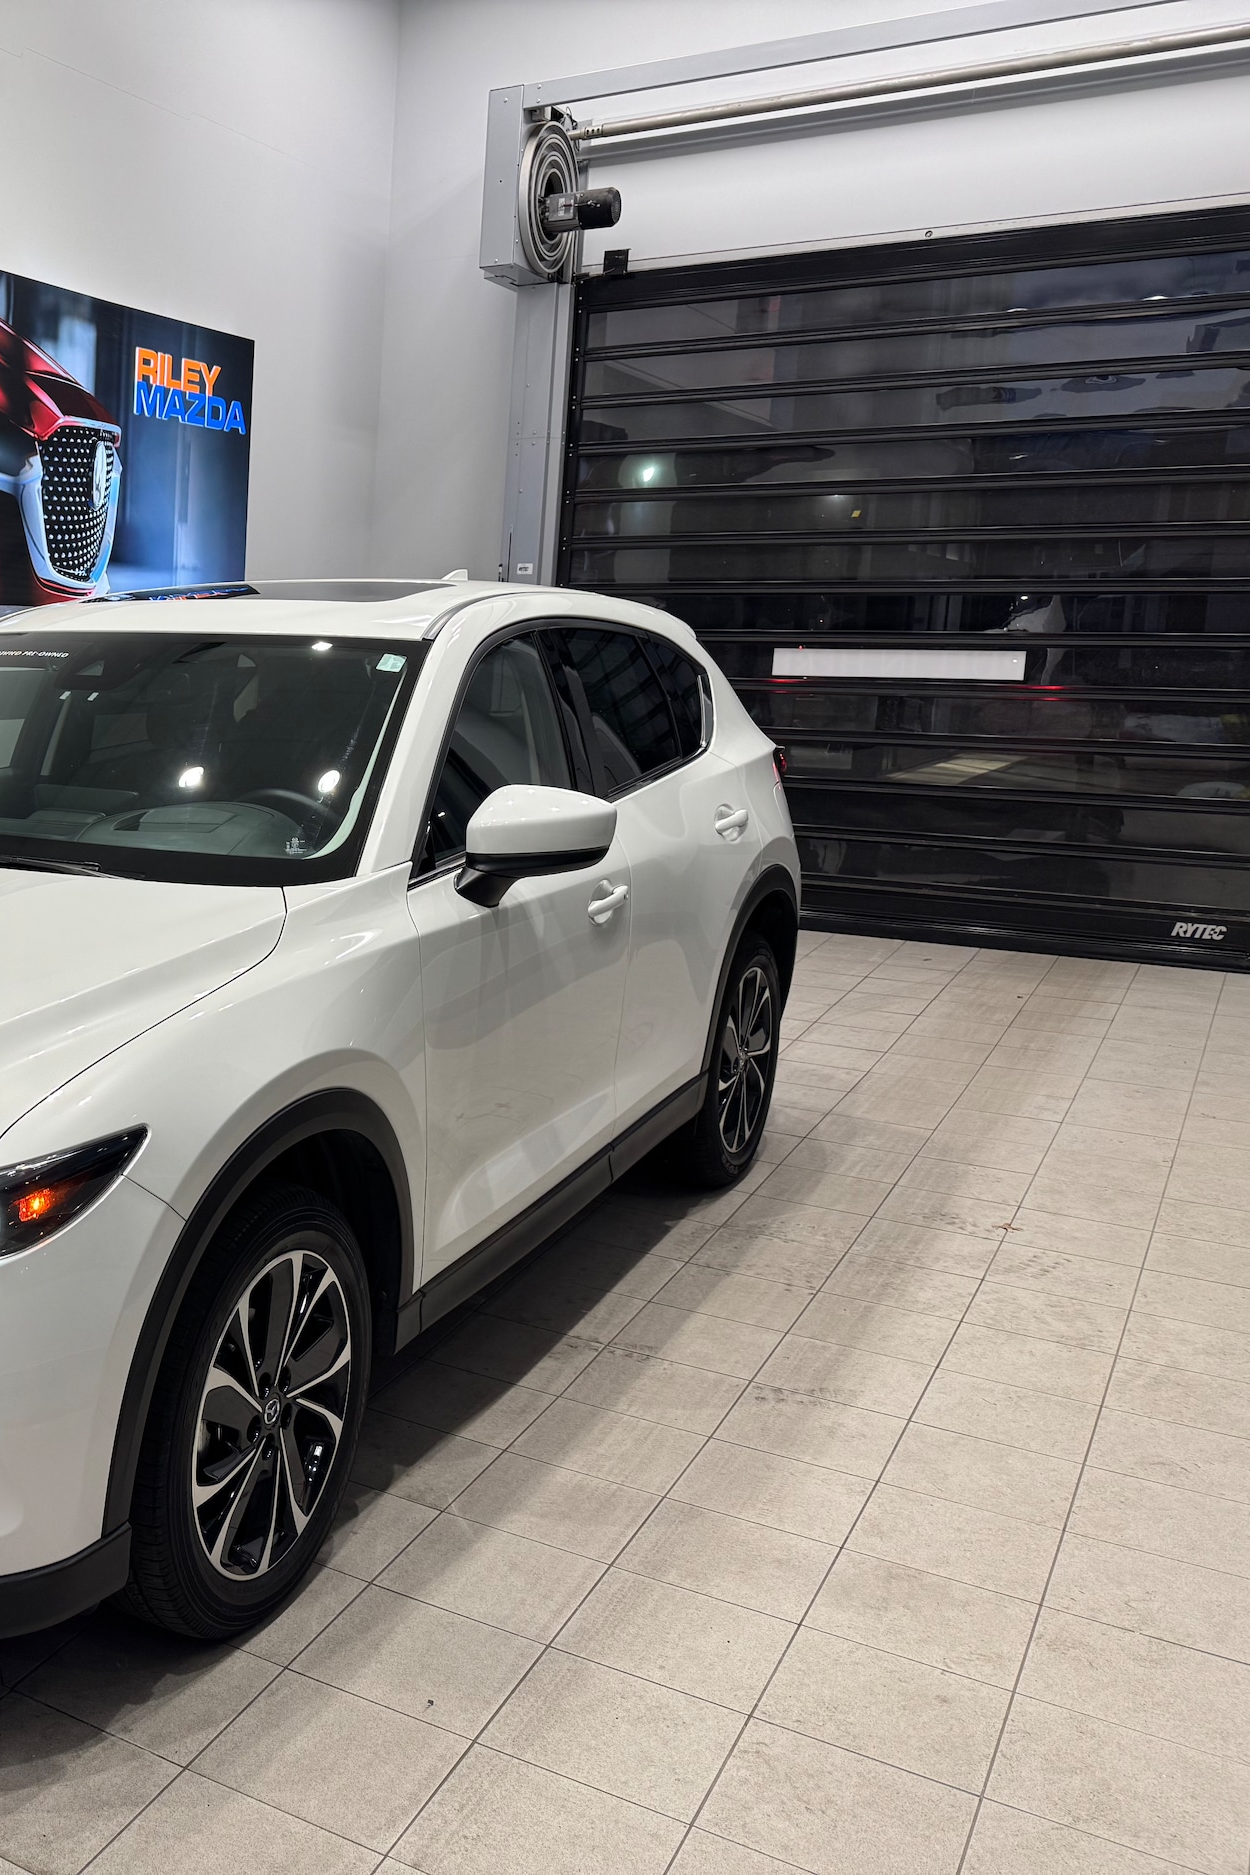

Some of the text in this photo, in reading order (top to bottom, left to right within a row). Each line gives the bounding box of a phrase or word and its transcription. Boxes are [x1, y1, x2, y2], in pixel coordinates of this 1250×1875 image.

[135, 346, 222, 396] RILEY
[133, 381, 247, 435] MAZDA
[1170, 922, 1228, 940] RYTEC
